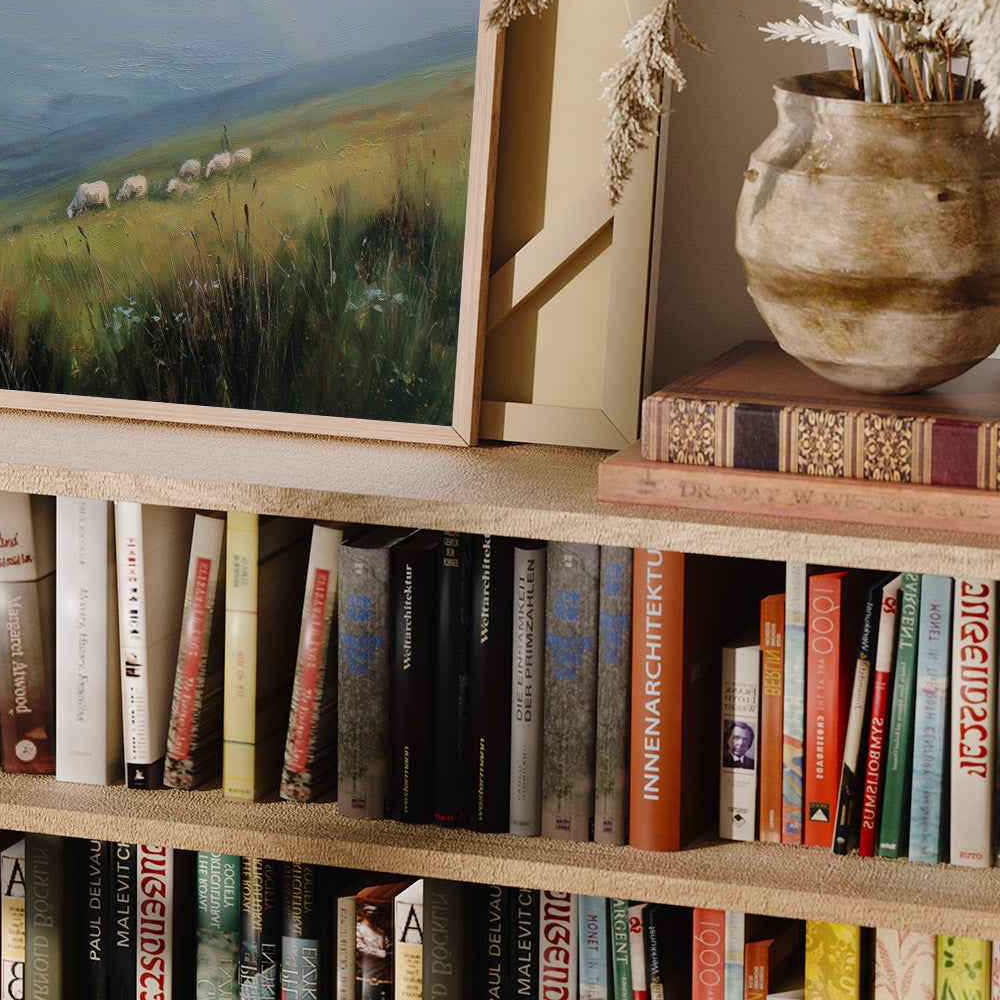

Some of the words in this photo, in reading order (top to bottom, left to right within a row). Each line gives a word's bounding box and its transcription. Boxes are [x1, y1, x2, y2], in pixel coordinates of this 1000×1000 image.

[6, 594, 26, 657] Margaret
[402, 563, 414, 671] Weltarchitektur
[523, 559, 536, 679] PRIMZAHLEN
[12, 661, 34, 714] Atwood
[523, 687, 535, 723] DER
[402, 745, 411, 814] westermann
[477, 737, 486, 821] westermann
[88, 839, 102, 910] DELVAU
[88, 916, 102, 962] PAUL
[487, 885, 502, 958] DELVAU
[586, 914, 600, 952] MONET
[613, 898, 629, 966] ARGENT
[649, 925, 660, 975] Werkkunst
[694, 921, 721, 987] 1900
